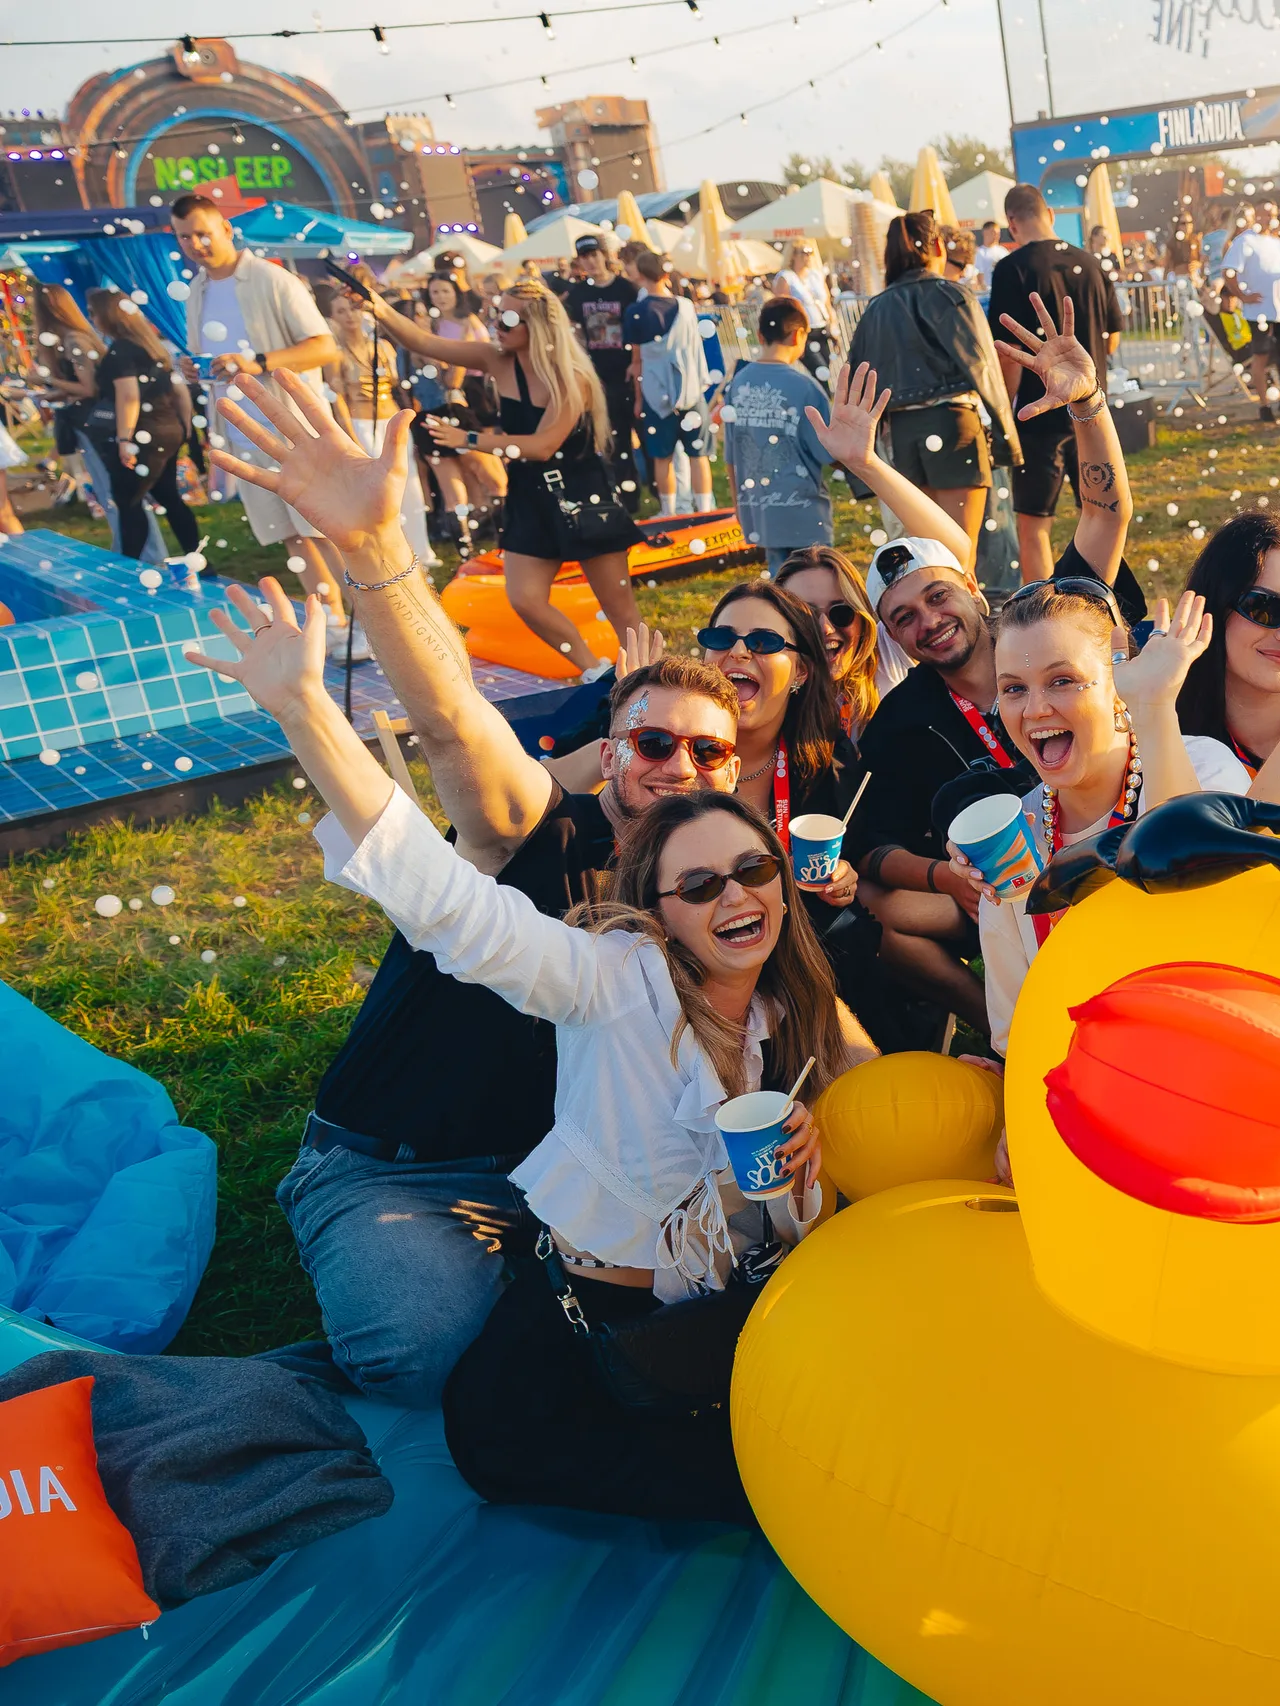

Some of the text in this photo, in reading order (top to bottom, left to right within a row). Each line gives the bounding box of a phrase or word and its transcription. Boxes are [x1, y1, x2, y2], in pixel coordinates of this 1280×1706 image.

[1158, 101, 1244, 148] FINLANDIA
[386, 593, 447, 661] INDIGNVS
[776, 800, 784, 832] FESTIVAL
[809, 855, 830, 867] IT'S
